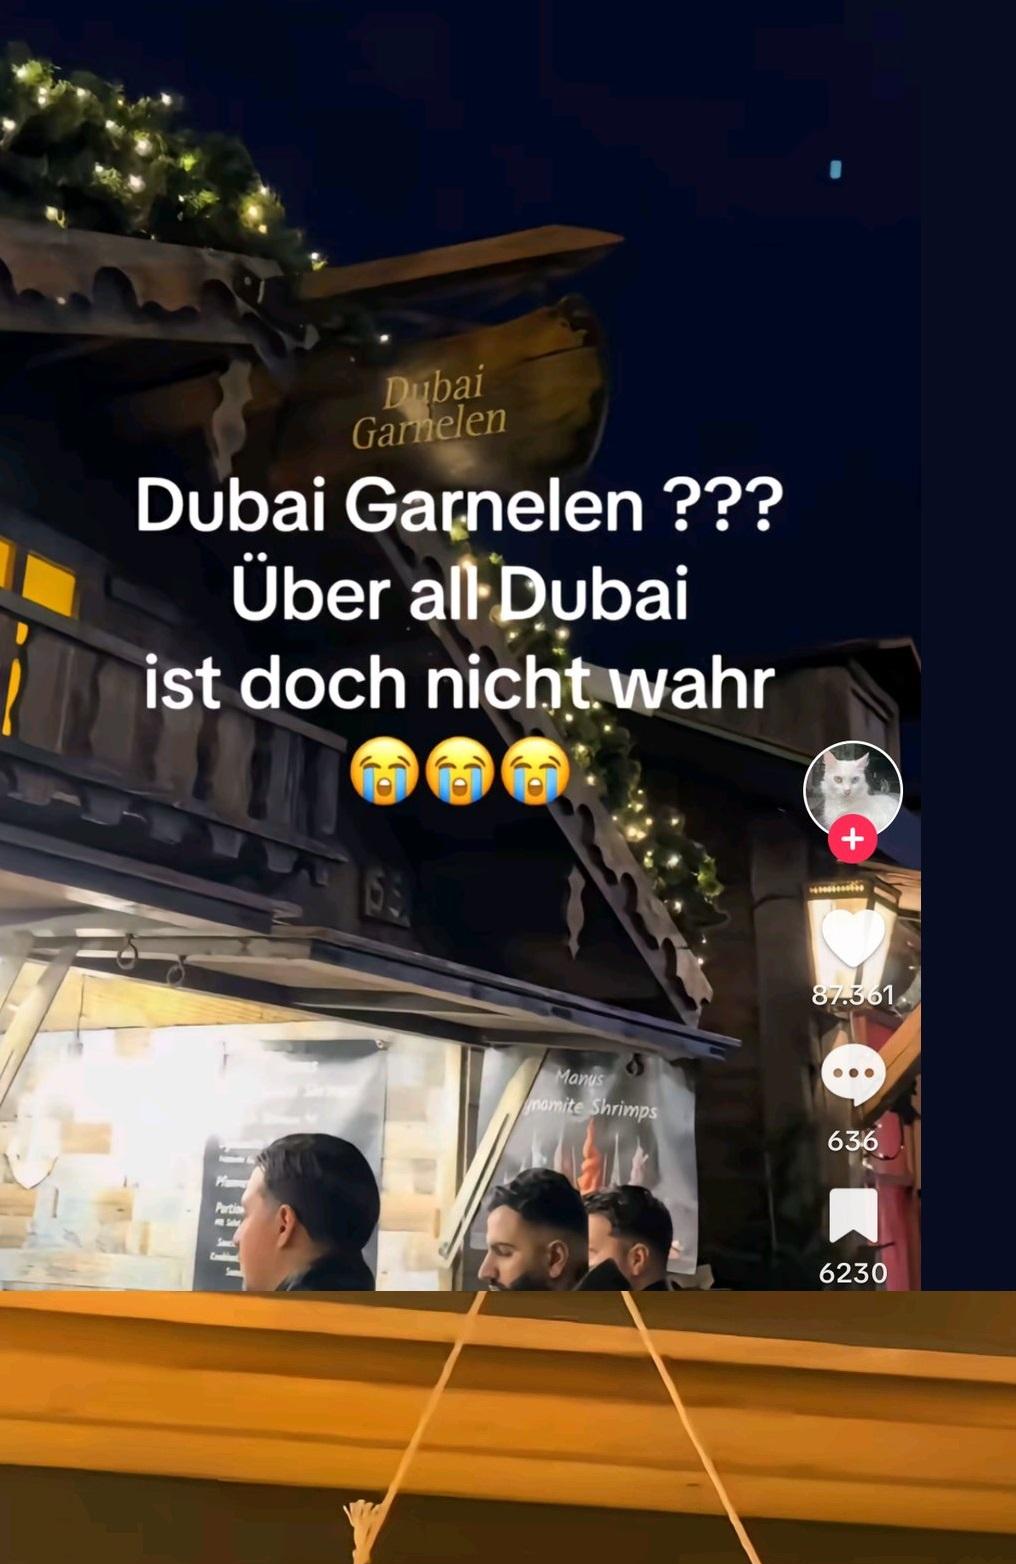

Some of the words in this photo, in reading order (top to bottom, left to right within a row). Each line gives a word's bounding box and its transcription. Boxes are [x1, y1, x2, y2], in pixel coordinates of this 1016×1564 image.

[382, 363, 485, 411] Dubai
[352, 403, 507, 450] Garnelen
[591, 1099, 659, 1122] Shrimps
